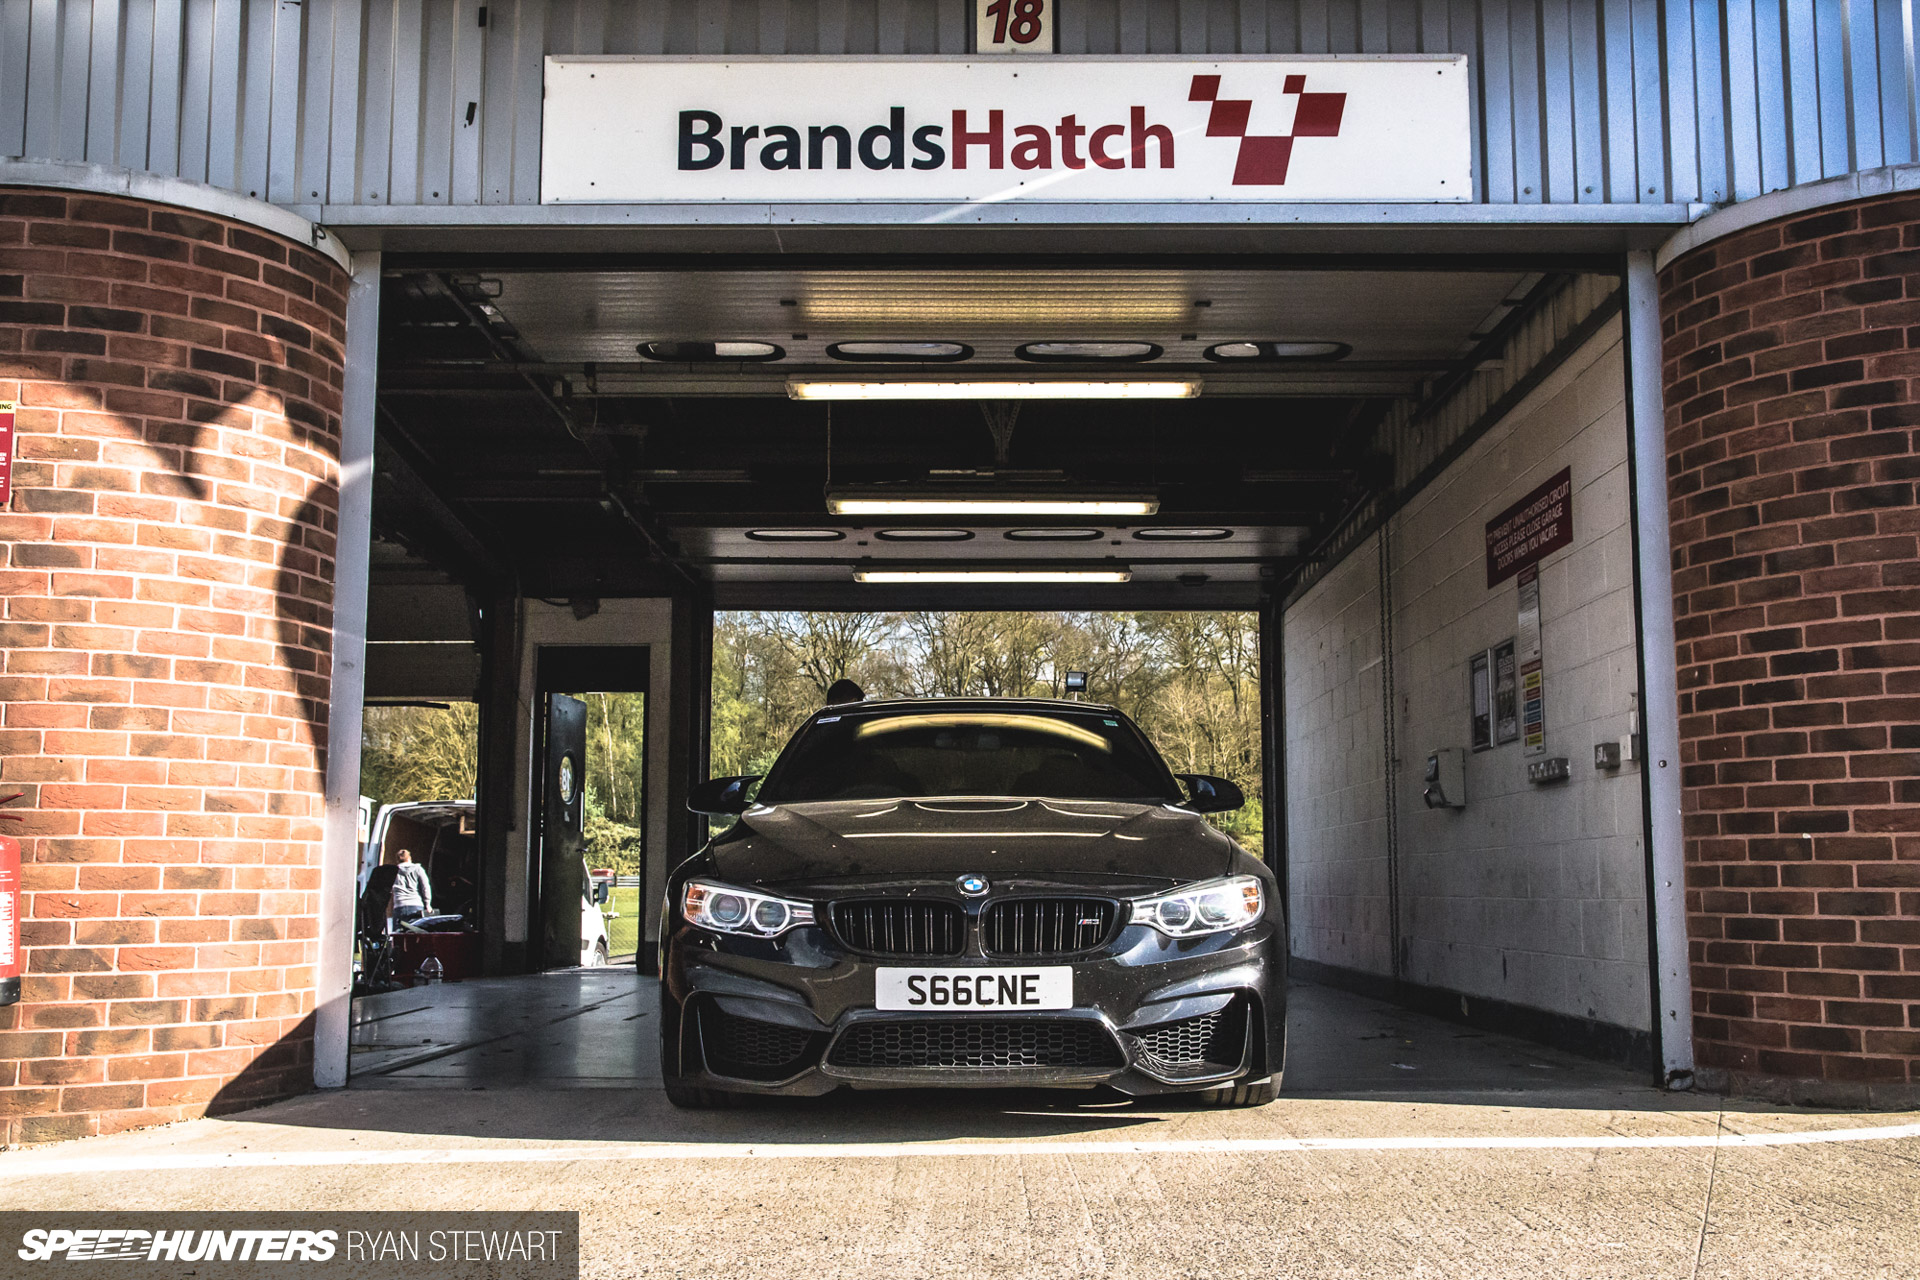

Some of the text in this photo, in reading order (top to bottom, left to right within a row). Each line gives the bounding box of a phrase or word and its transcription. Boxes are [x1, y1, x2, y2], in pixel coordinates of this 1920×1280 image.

[986, 0, 1044, 44] 18
[678, 106, 1175, 171] BrandsHatch
[1493, 519, 1512, 541] PREVENT
[1512, 495, 1549, 529] UNAUTHORISED
[1549, 480, 1569, 505] CIRCUIT
[1493, 502, 1563, 558] ACCESS PLEASE CLOSE GARAGE
[1497, 522, 1558, 570] DOORS WHEN YOU VACATE
[907, 975, 1041, 1006] S66CNE
